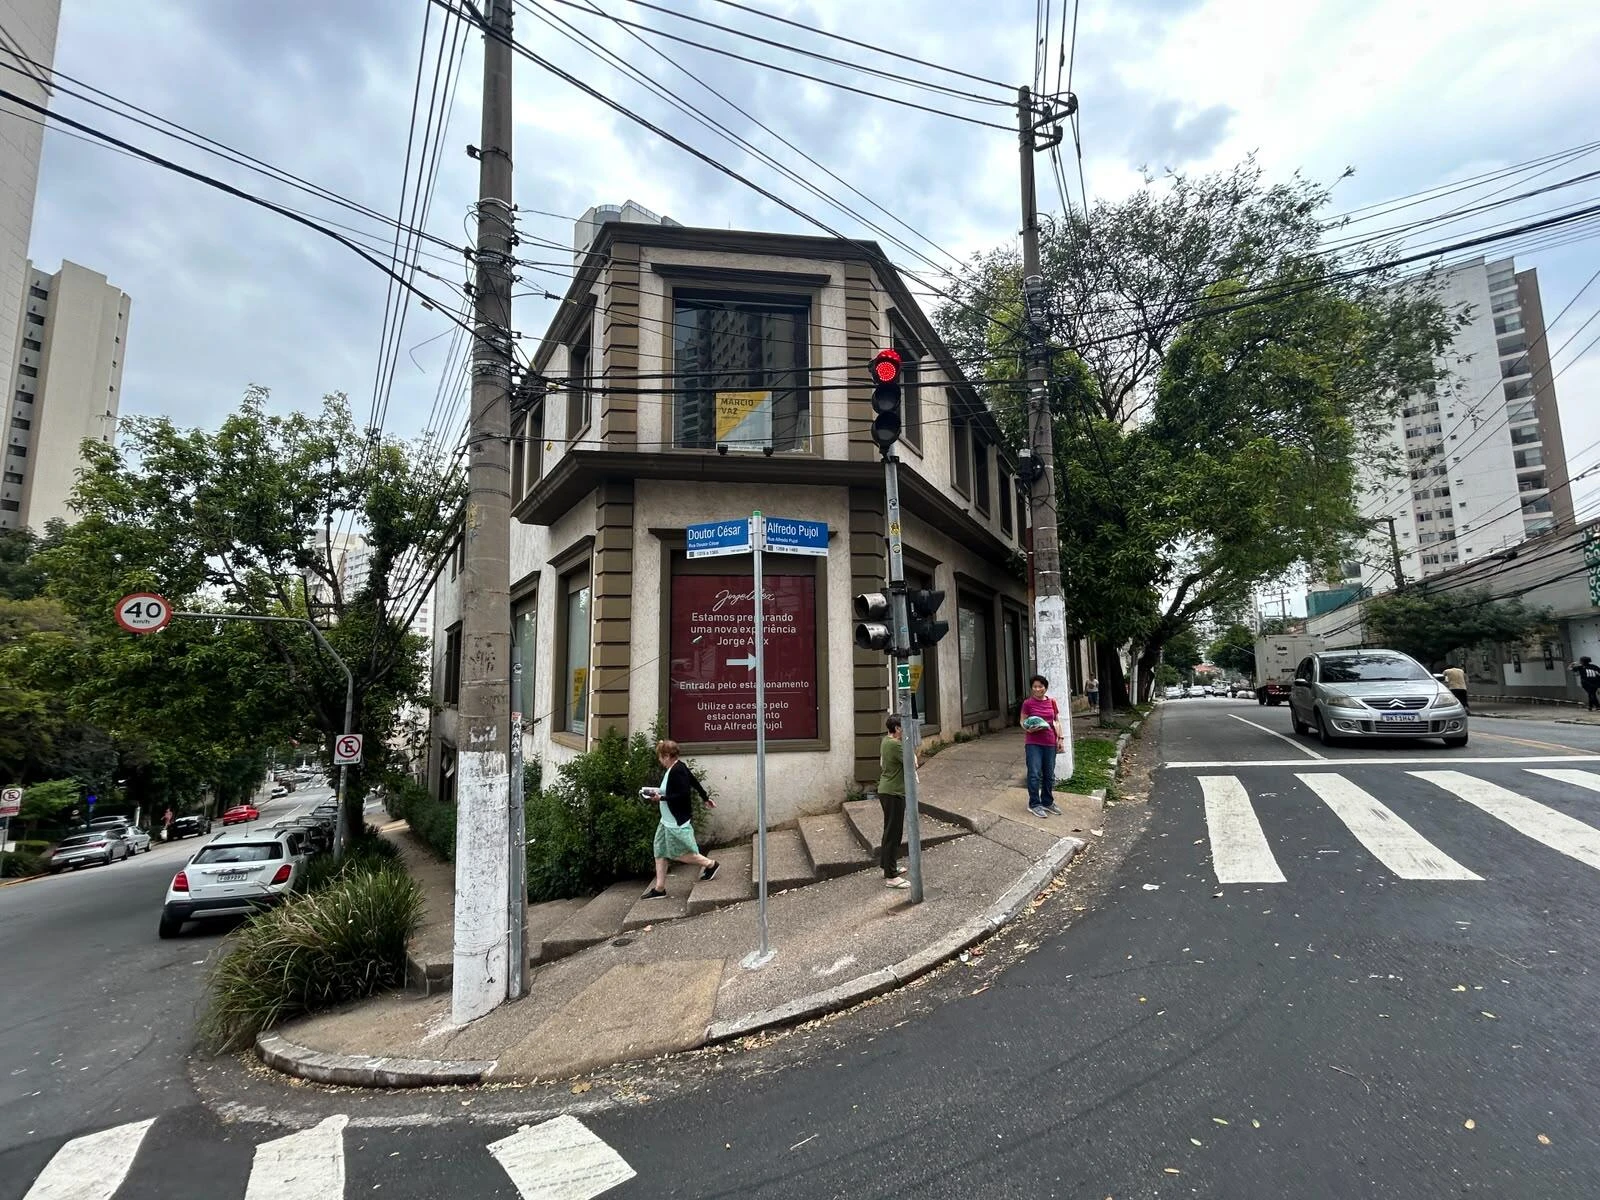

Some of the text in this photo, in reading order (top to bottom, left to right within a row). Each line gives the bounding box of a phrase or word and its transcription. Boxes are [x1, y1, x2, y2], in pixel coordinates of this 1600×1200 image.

[688, 525, 741, 541] Doutor César
[767, 522, 819, 539] Alfredo Pujol
[124, 601, 162, 618] 40
[691, 612, 794, 624] Estamos prerando
[690, 623, 797, 636] uma nova expriência
[716, 636, 769, 648] Jorge Ax
[679, 681, 715, 691] Entrada
[717, 681, 737, 692] pelo
[697, 701, 727, 712] Utilize
[735, 702, 768, 710] aceso
[769, 700, 789, 712] pelo
[704, 721, 783, 732] Rua Alfredo ujol
